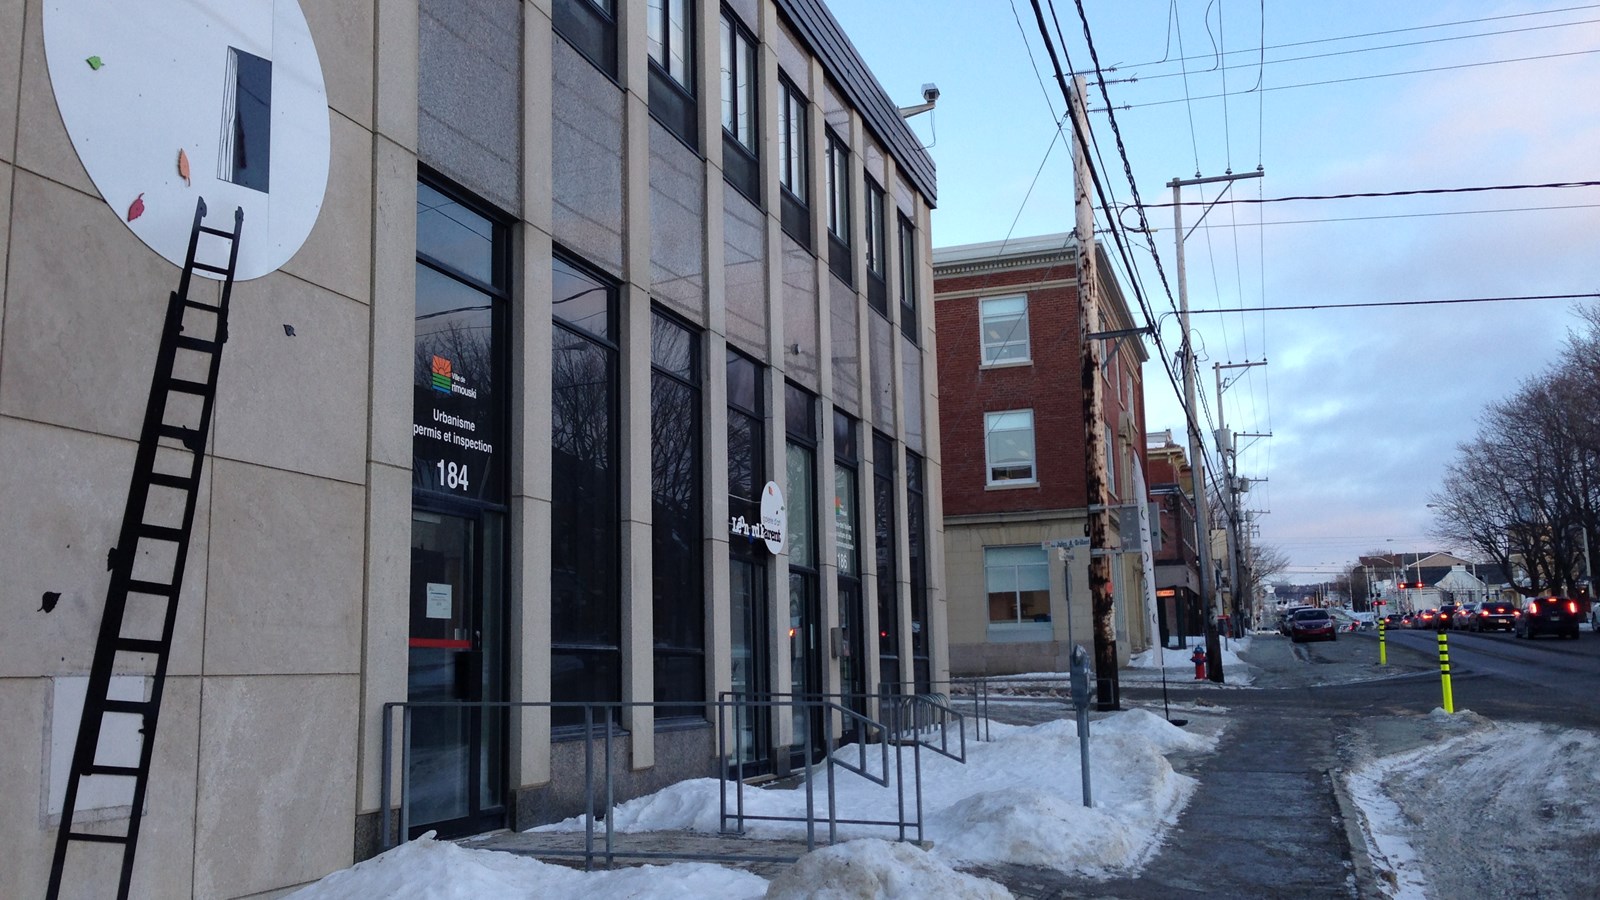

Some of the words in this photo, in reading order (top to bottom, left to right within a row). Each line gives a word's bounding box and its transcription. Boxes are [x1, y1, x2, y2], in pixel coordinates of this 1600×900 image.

[451, 382, 477, 399] rimouski
[433, 408, 476, 432] Urbanisme
[413, 423, 442, 440] permis
[443, 431, 452, 443] et
[453, 431, 493, 454] inspection
[437, 459, 469, 491] 184
